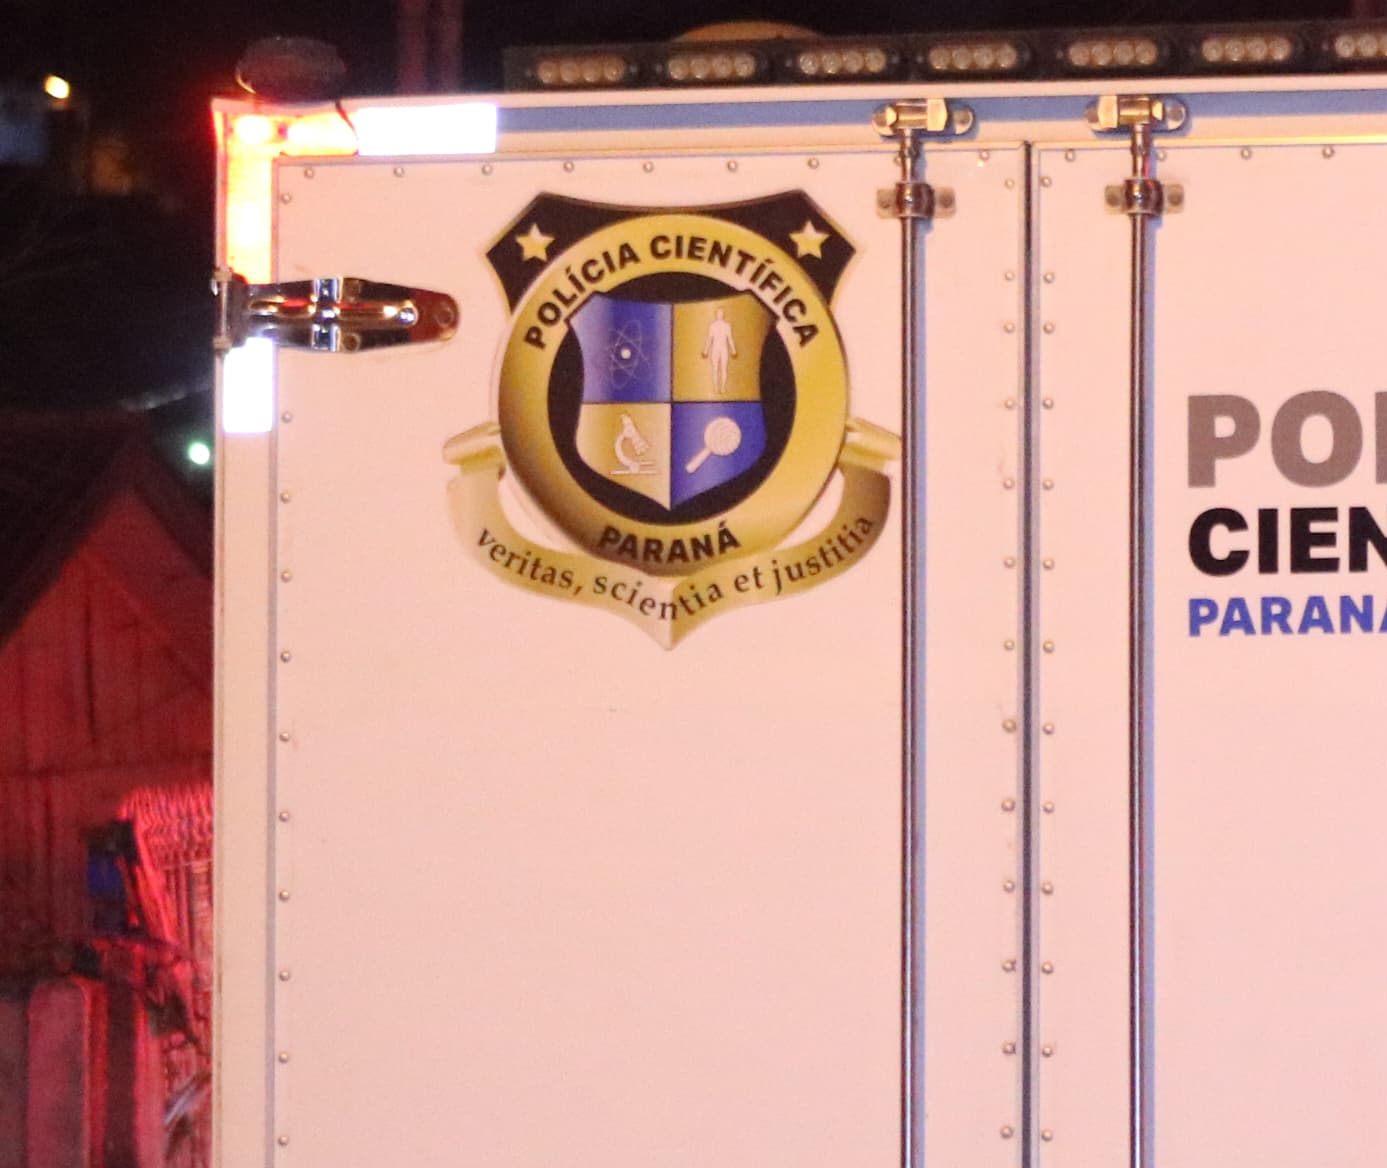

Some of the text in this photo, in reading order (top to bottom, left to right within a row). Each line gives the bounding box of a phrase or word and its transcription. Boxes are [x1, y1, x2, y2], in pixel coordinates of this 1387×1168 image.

[524, 235, 819, 350] POLÍCIA CIENTÍFICA
[477, 514, 874, 621] veritas, scientia et justitia
[599, 520, 741, 565] PARANÁ
